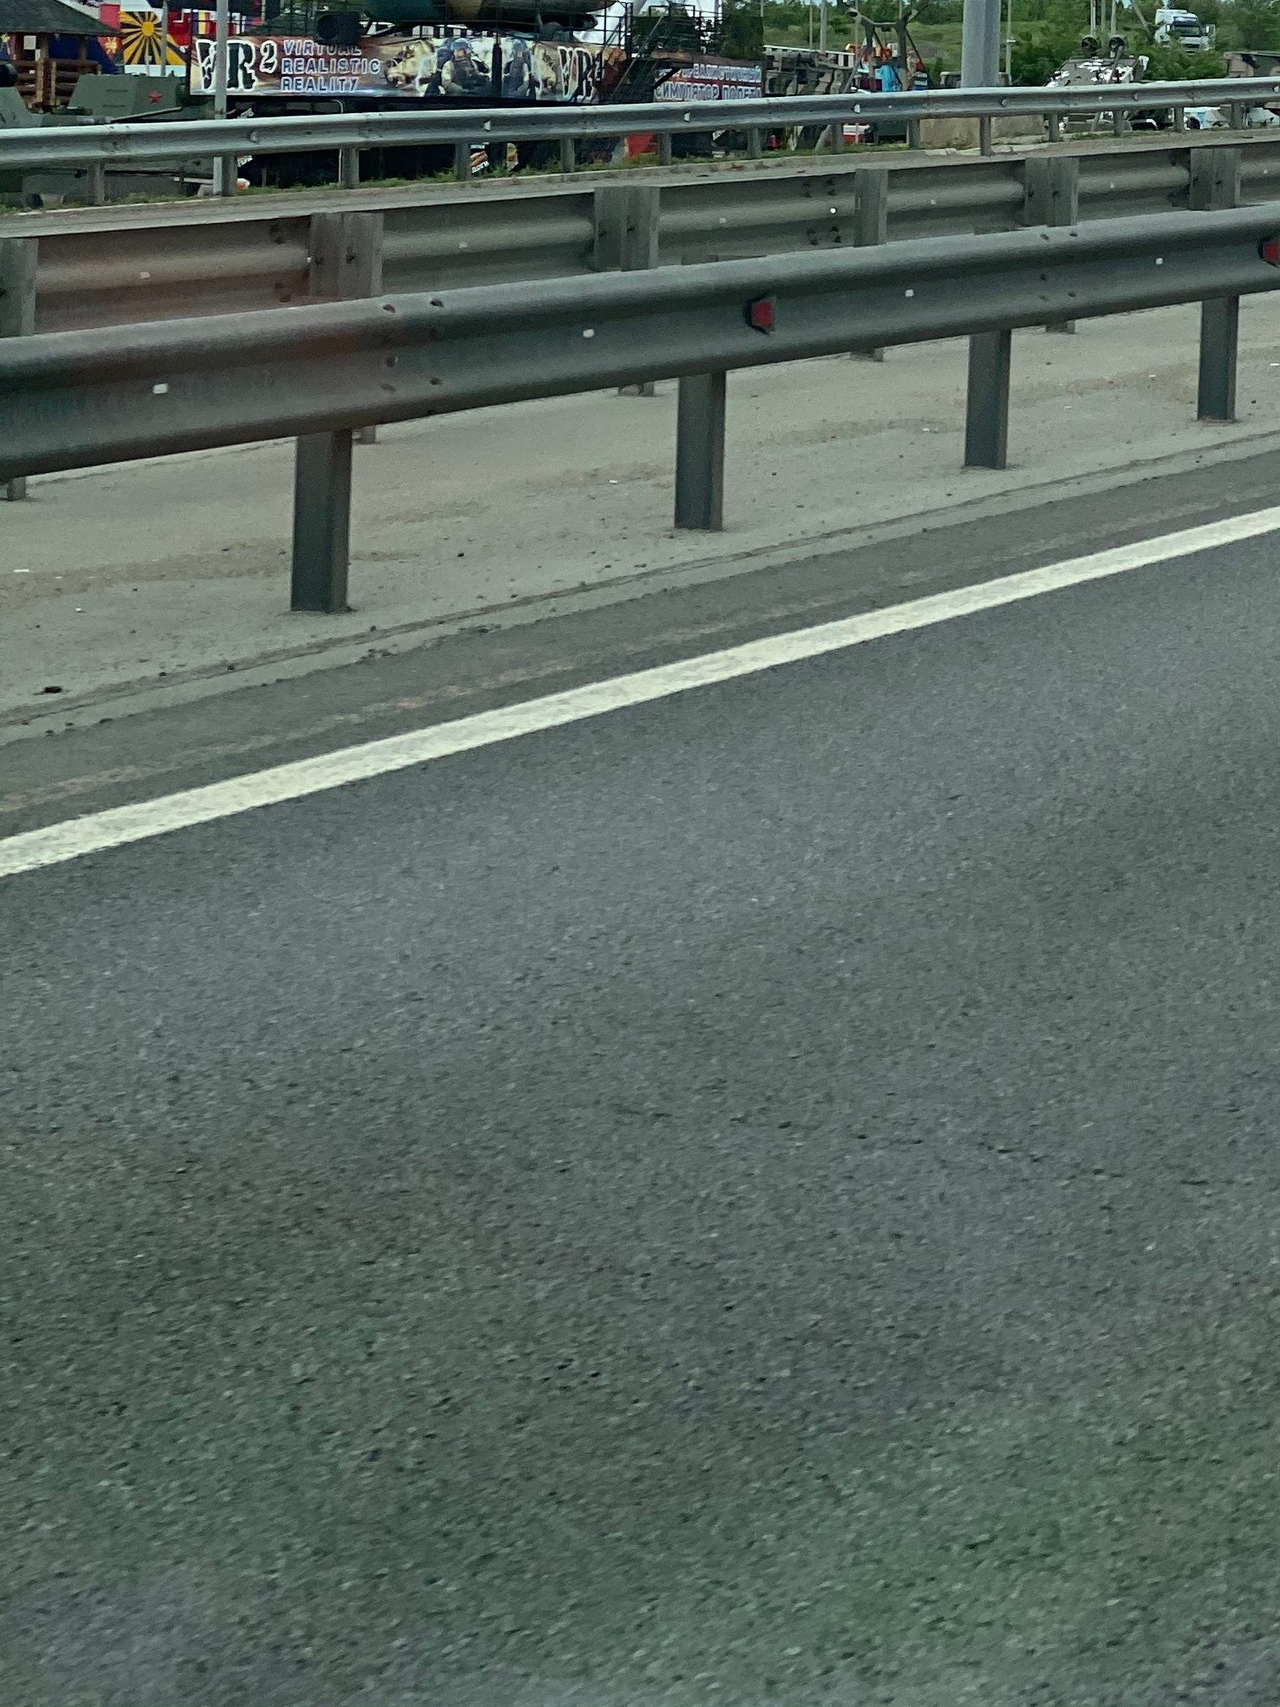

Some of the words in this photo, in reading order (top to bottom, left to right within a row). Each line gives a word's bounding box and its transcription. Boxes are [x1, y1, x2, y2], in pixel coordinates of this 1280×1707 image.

[283, 39, 362, 56] VIRTUAL
[280, 57, 382, 75] REALISTIC
[280, 76, 360, 93] REALITY
